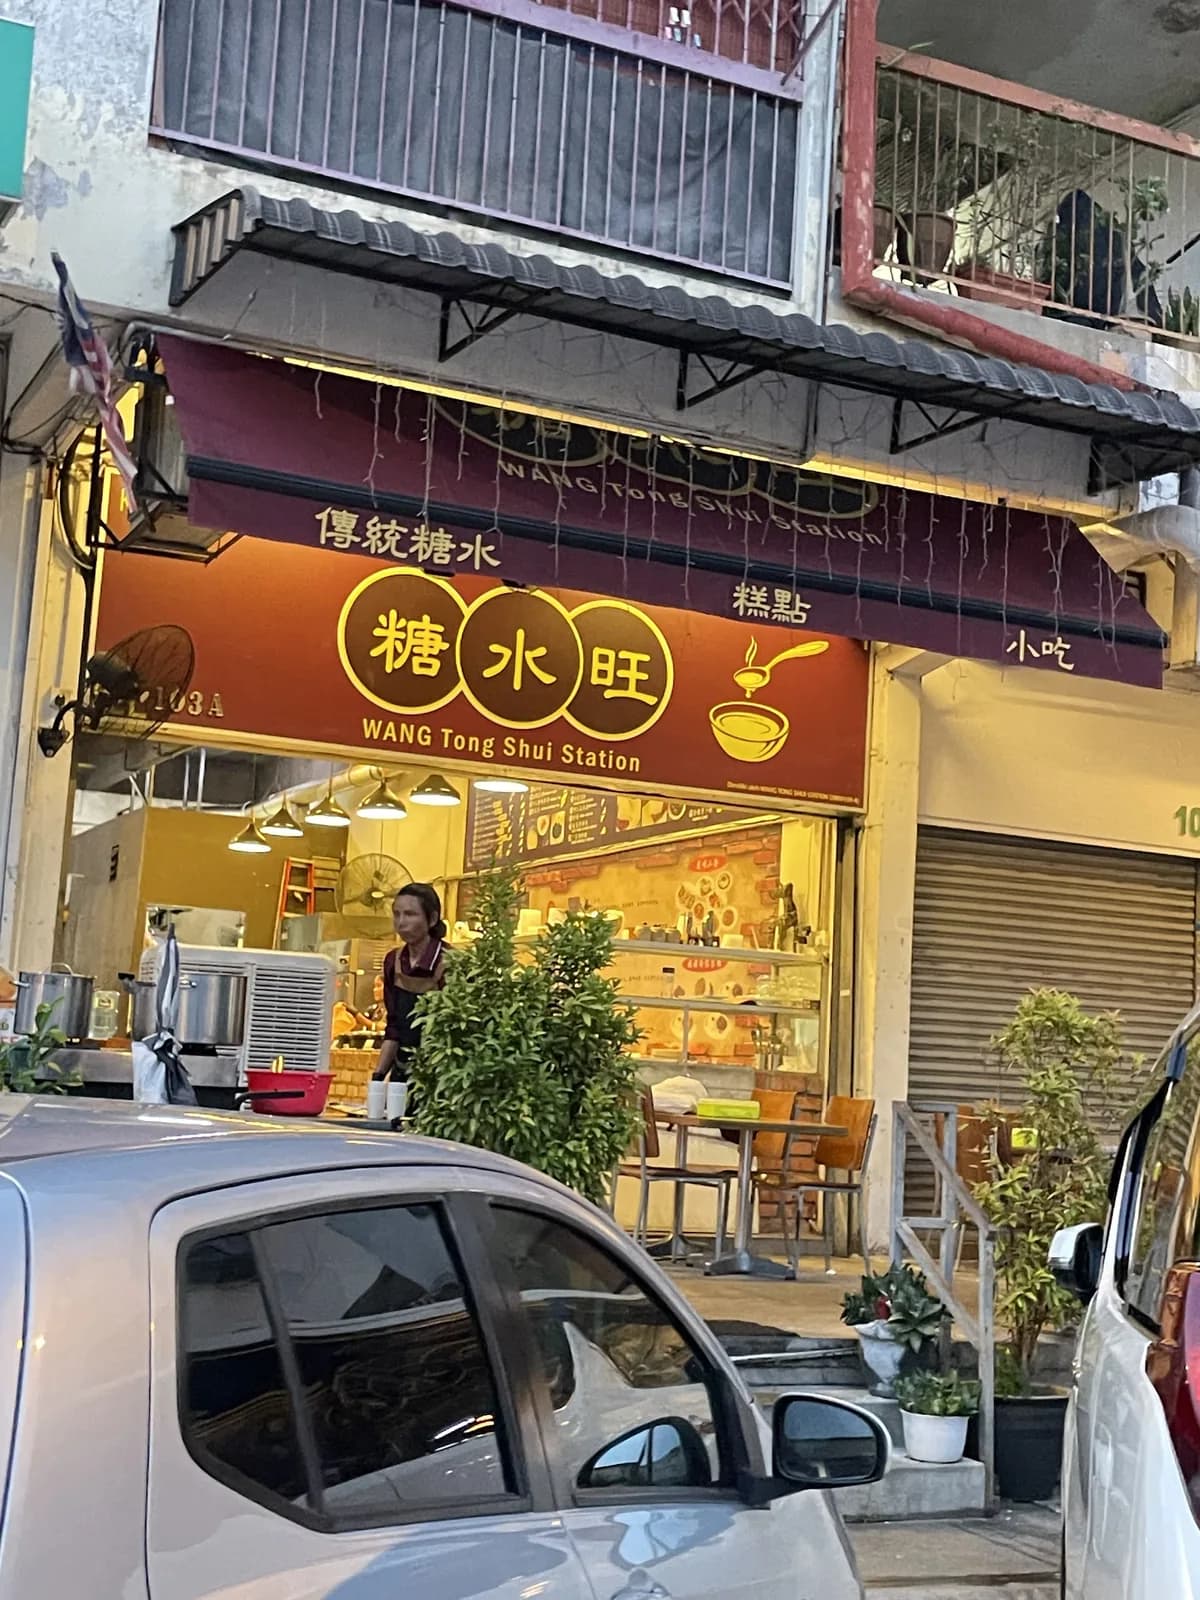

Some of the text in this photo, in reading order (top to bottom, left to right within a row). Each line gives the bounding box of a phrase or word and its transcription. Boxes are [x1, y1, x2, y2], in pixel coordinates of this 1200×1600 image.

[499, 460, 883, 546] WANG Tong Shui Station
[314, 506, 502, 571] 傳統糖水
[732, 582, 812, 624] 糕點
[1006, 629, 1075, 671] 小吃
[362, 718, 641, 772] WANG Tong Shui Station
